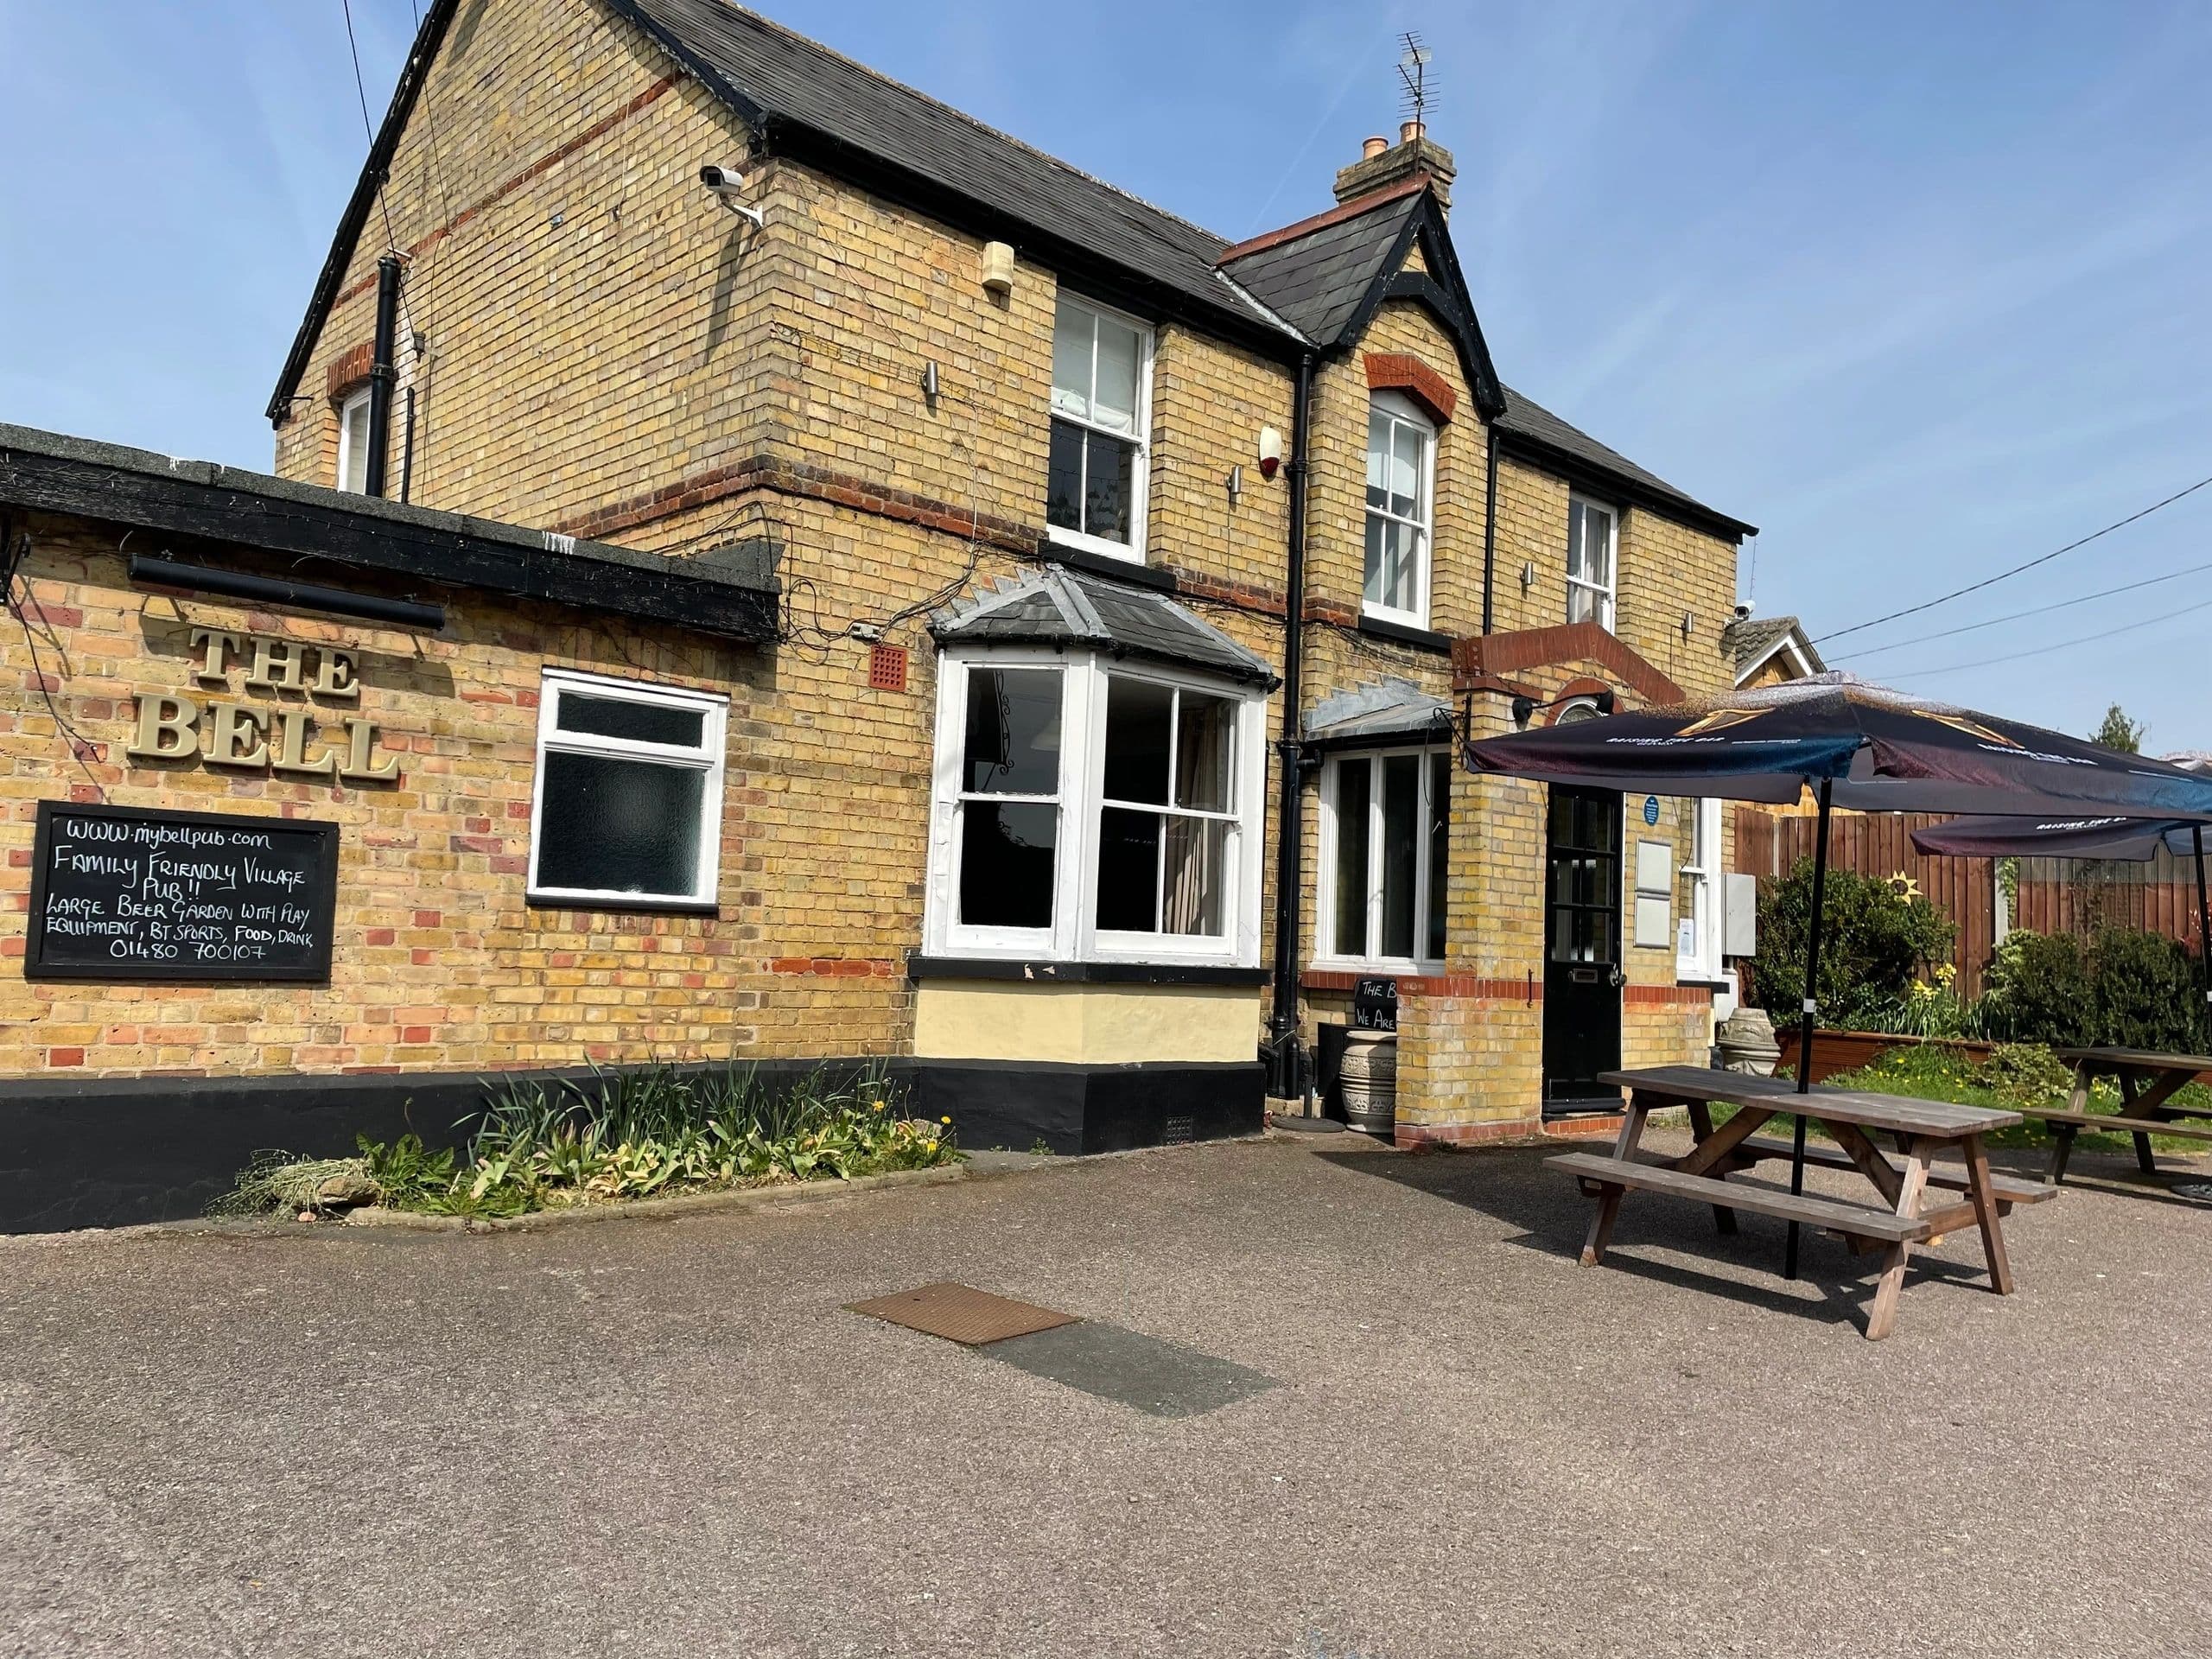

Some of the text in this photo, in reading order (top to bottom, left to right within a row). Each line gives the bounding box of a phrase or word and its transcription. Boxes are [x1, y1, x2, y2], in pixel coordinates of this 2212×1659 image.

[189, 627, 360, 697] THE
[125, 690, 399, 779] BELL
[54, 844, 306, 893] FAMILY FRIENDLY VILLAGE
[46, 892, 311, 931] LARGE BEER GARDEN WITH PLAY
[110, 938, 266, 961] 01480 700107
[149, 921, 172, 941] BT
[277, 929, 314, 949] DRINK
[1362, 981, 1383, 997] THE
[1356, 1007, 1395, 1030] WE ARE
